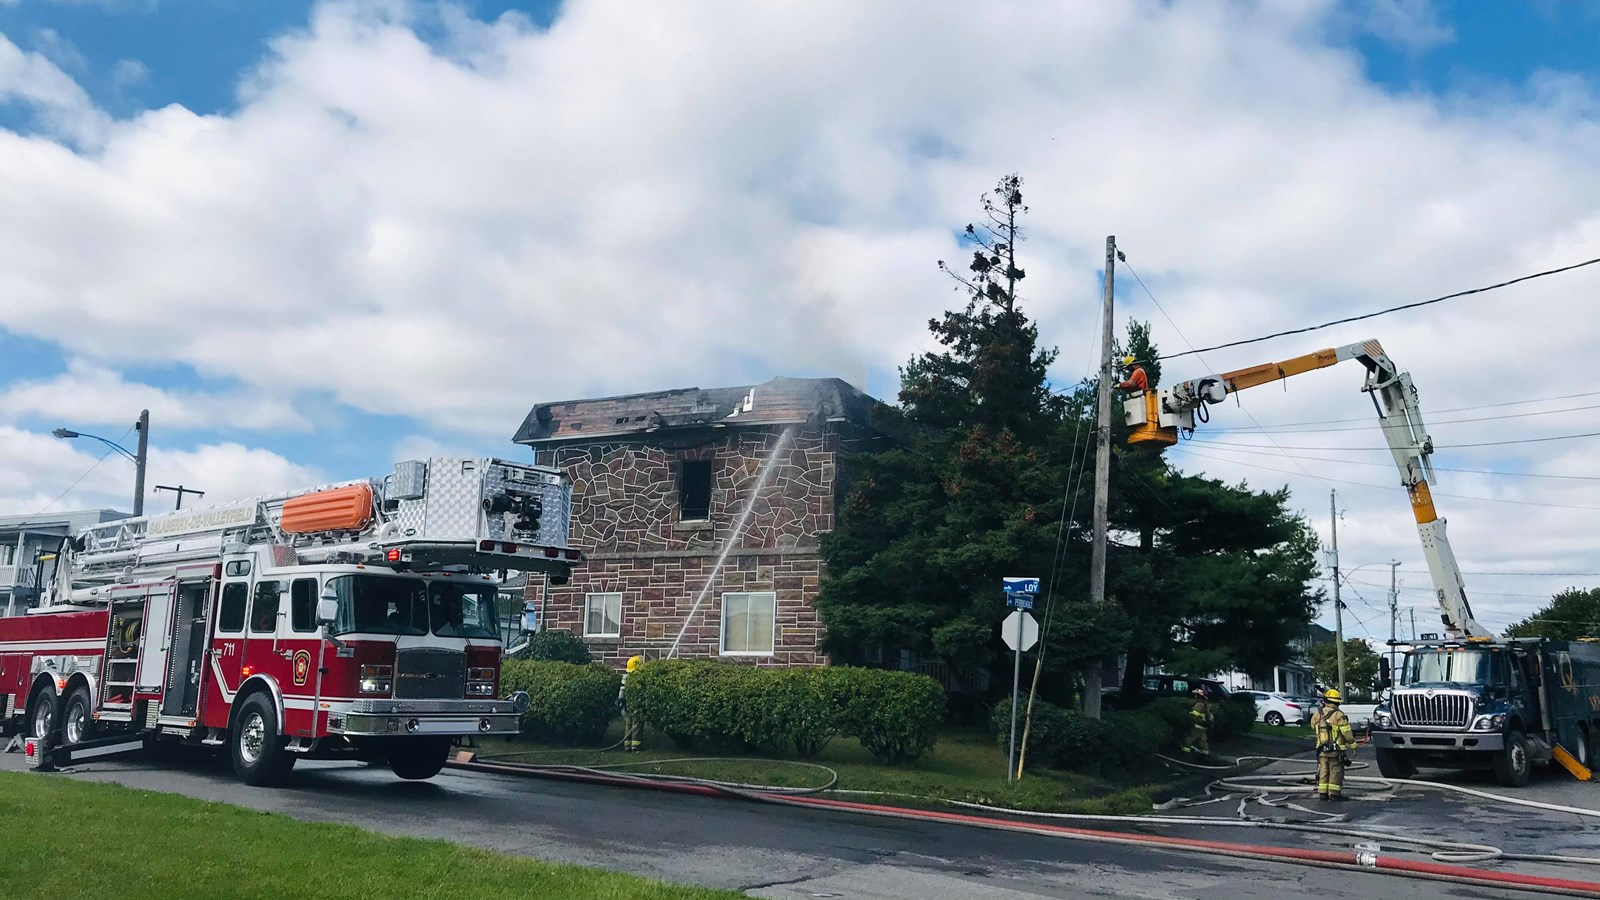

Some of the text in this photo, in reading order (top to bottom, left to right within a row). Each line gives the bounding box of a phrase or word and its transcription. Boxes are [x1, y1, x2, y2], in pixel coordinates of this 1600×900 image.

[149, 507, 253, 535] SALABERRY-DE-VALLEYFIELD
[1024, 584, 1038, 592] LOY
[223, 643, 235, 656] 711
